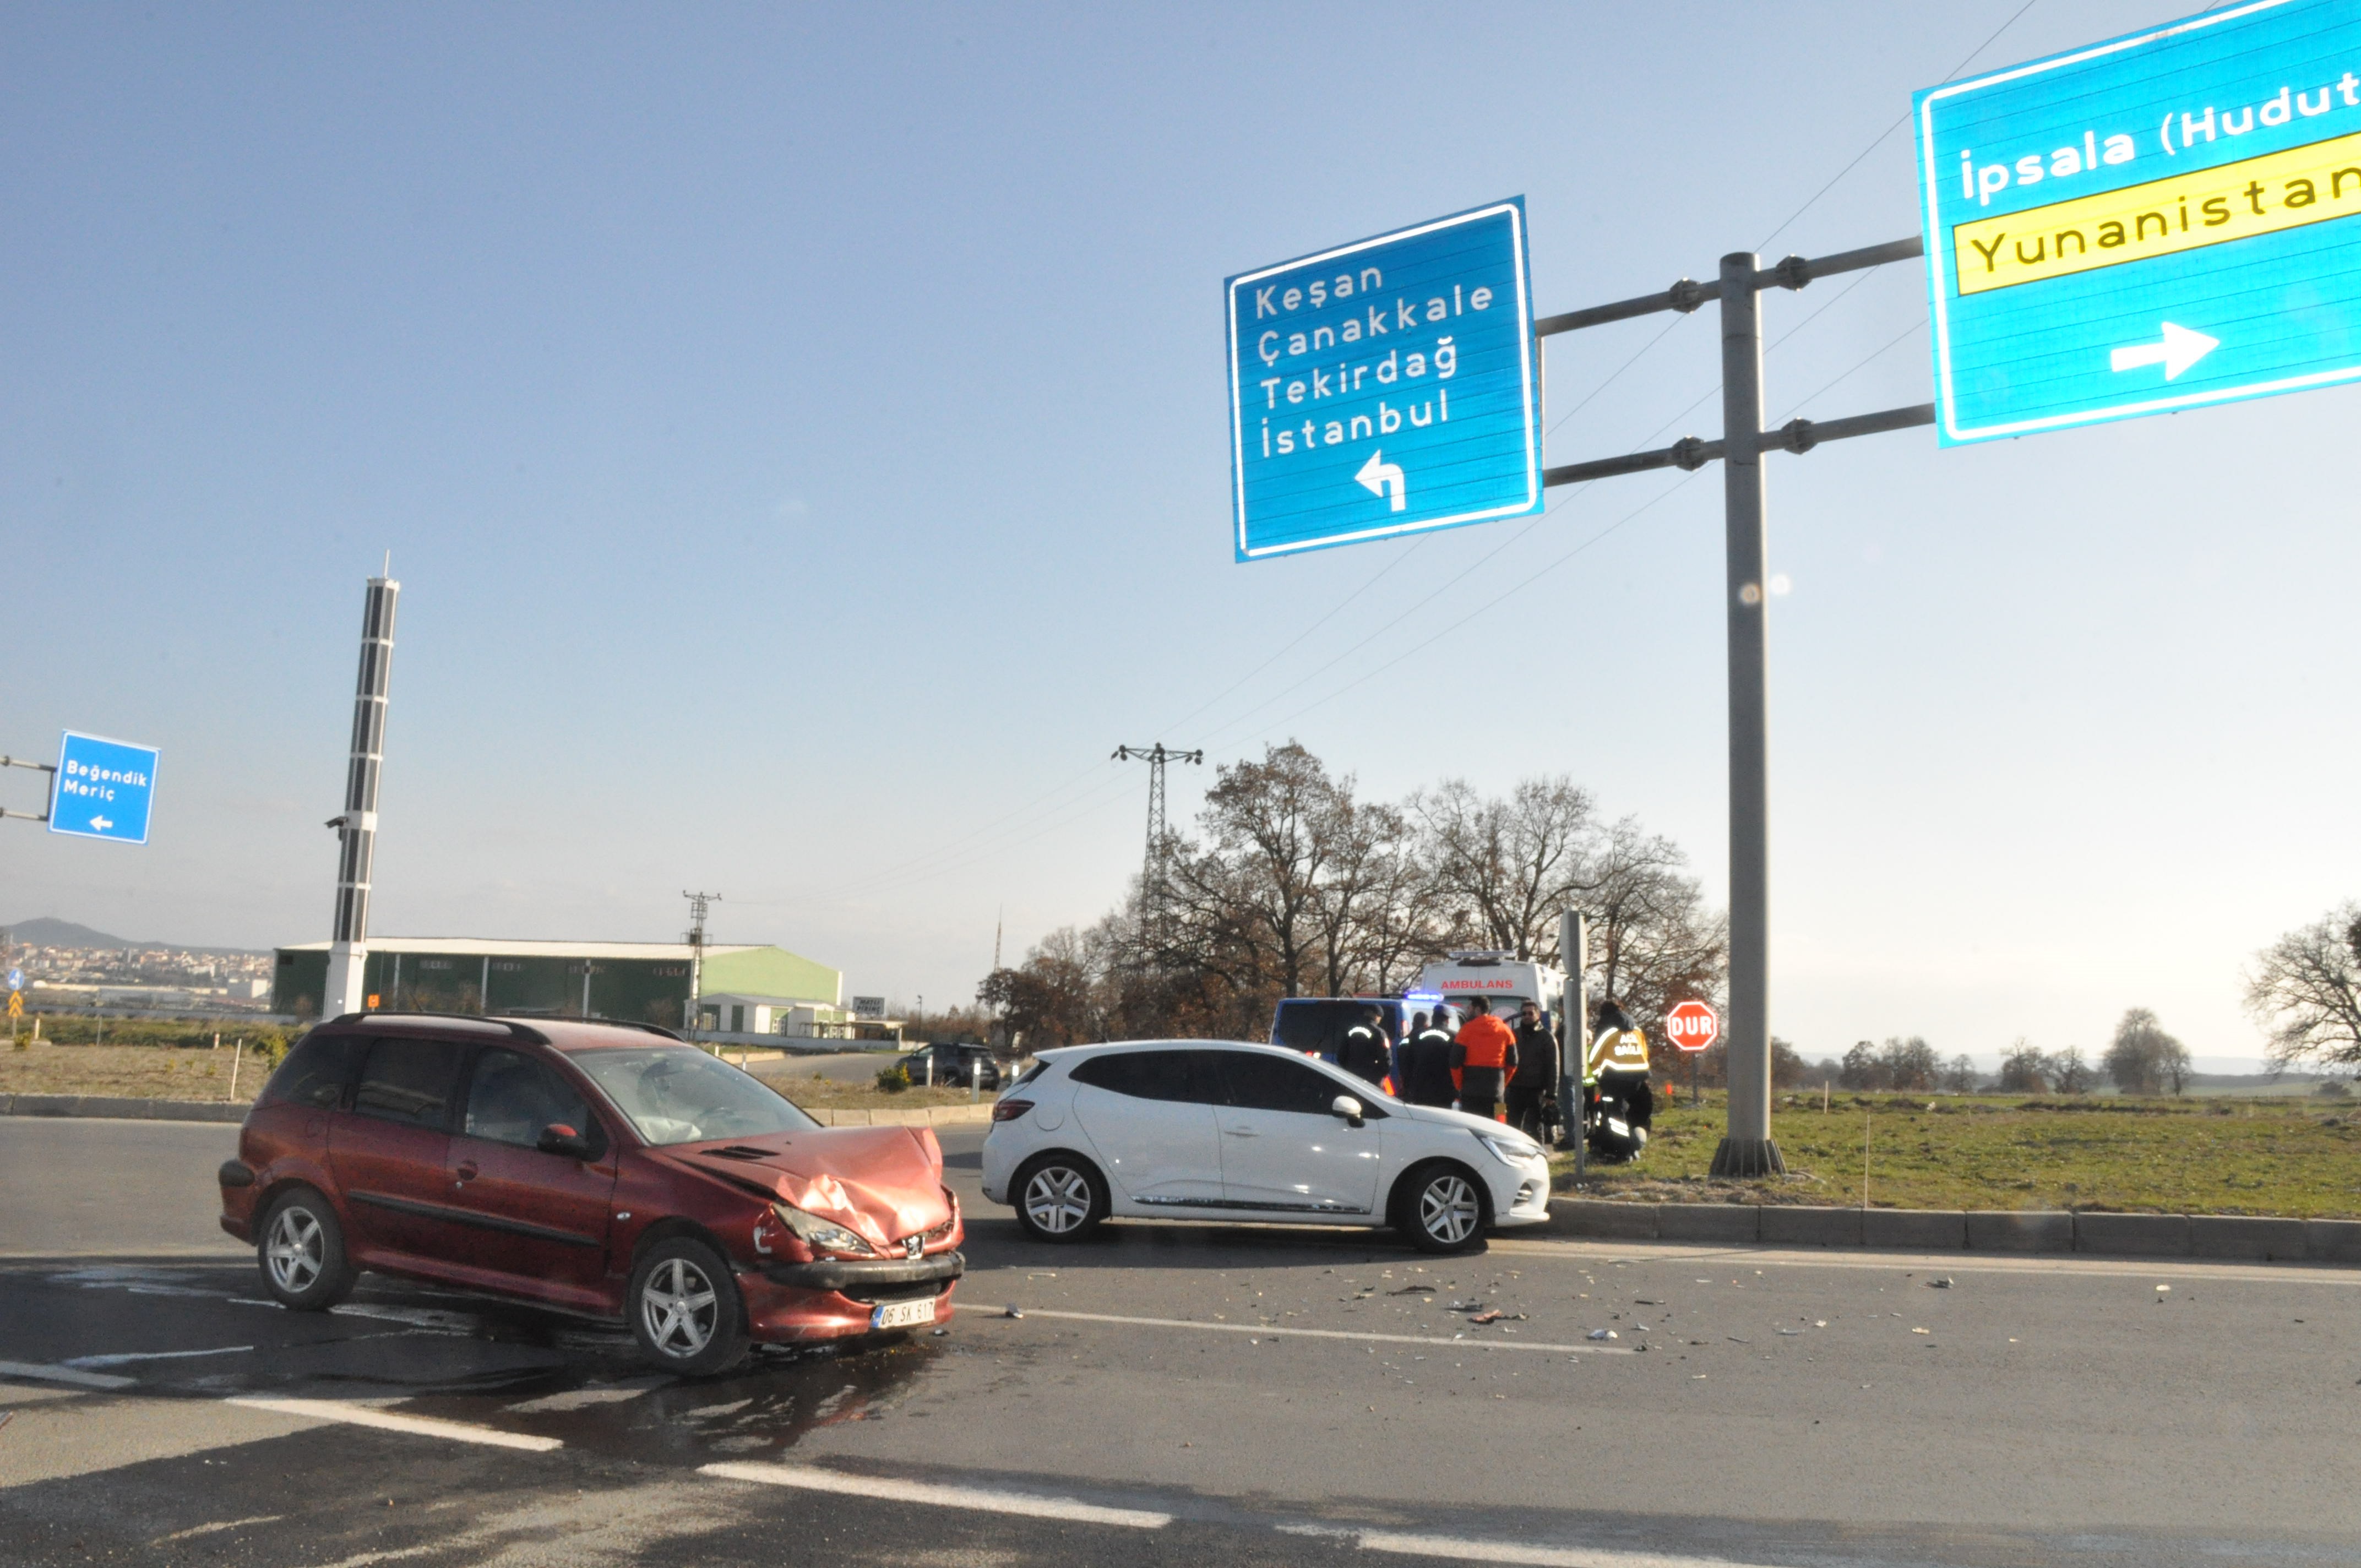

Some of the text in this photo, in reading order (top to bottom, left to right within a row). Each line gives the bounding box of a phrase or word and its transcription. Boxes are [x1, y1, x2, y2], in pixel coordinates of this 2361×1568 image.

[1961, 130, 2135, 206] İpsala
[1971, 167, 2361, 273] Yunanistan
[1256, 266, 1381, 319] Keşan
[1259, 284, 1493, 366] Çanakkale
[1260, 335, 1457, 409] Tekirdağ
[1261, 388, 1448, 458] İstanbul
[63, 779, 115, 802] Meriç
[66, 760, 147, 787] Beğendik
[1441, 979, 1513, 989] AMBULANS
[1672, 1015, 1712, 1036] DUR
[882, 1308, 895, 1325] 06
